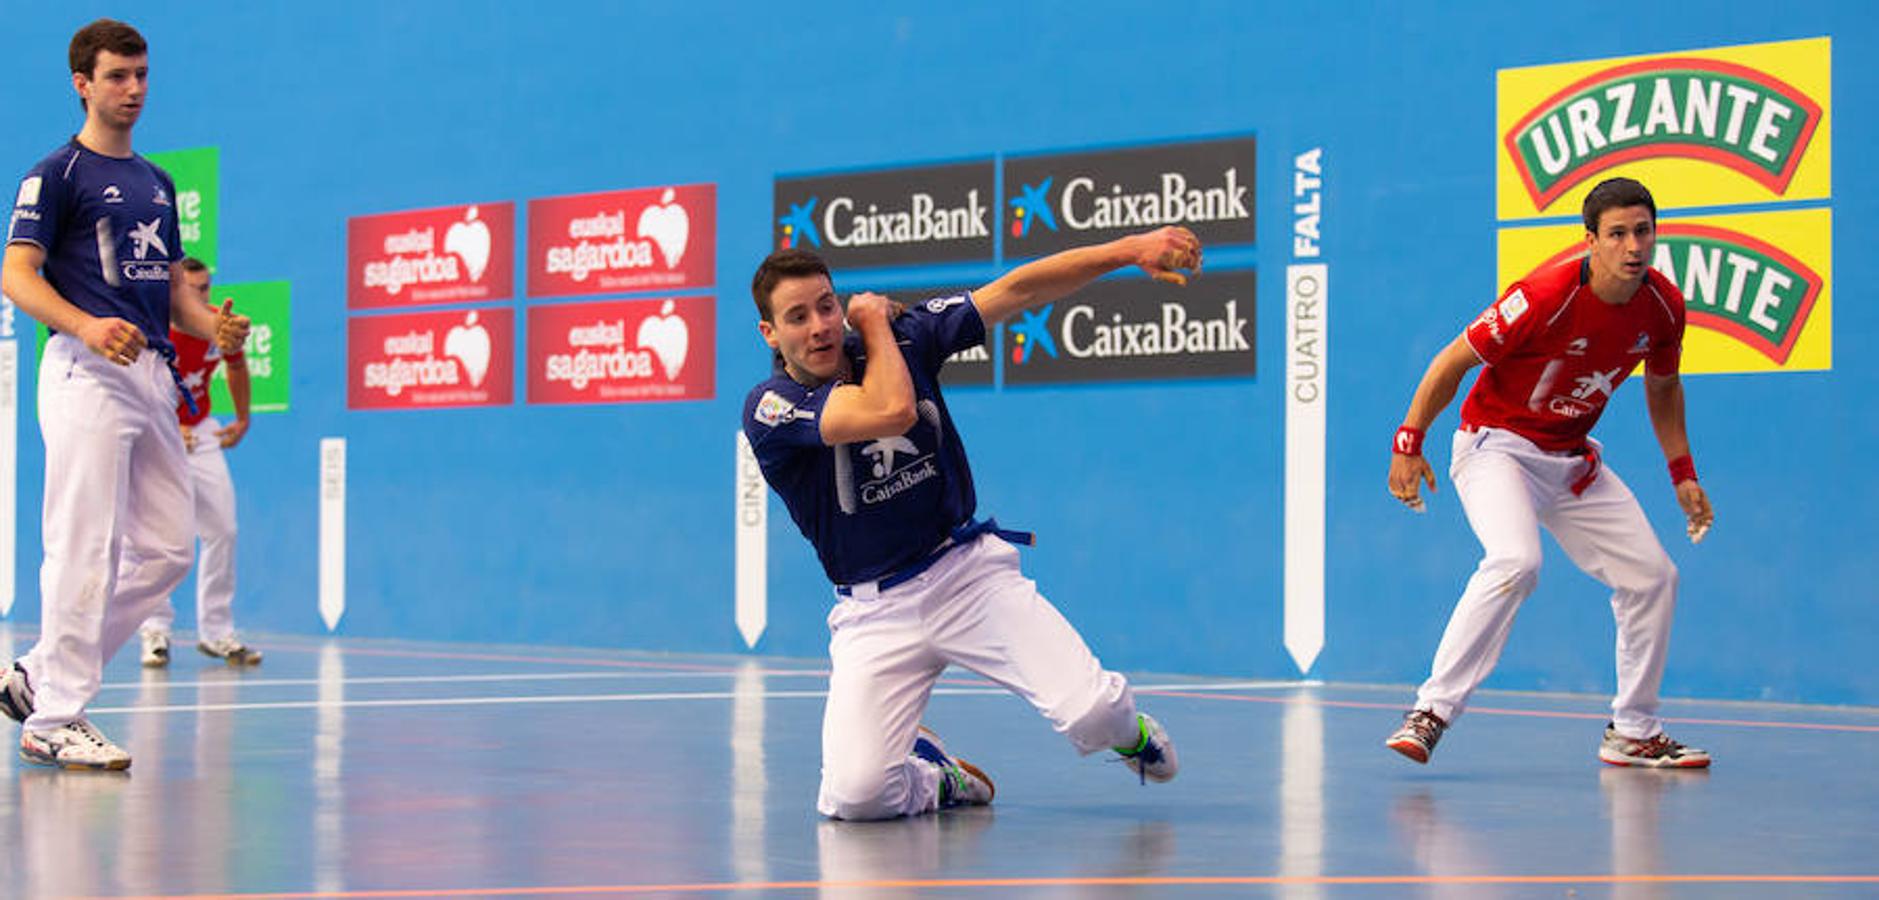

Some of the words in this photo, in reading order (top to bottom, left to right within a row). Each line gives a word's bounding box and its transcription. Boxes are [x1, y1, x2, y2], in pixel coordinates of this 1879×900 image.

[1531, 77, 1792, 176] URZANTE
[824, 190, 989, 248] CaixaBank
[1061, 168, 1249, 231] CaixaBank
[1293, 147, 1322, 258] FALTA
[364, 252, 459, 294] sagardoa
[547, 236, 653, 282] sagardoa
[1651, 243, 1792, 333] ANTE
[1062, 300, 1249, 358] CaixaBank
[1295, 275, 1319, 404] CUATRO
[364, 354, 459, 396] sagardoa
[547, 346, 653, 390] sagardoa
